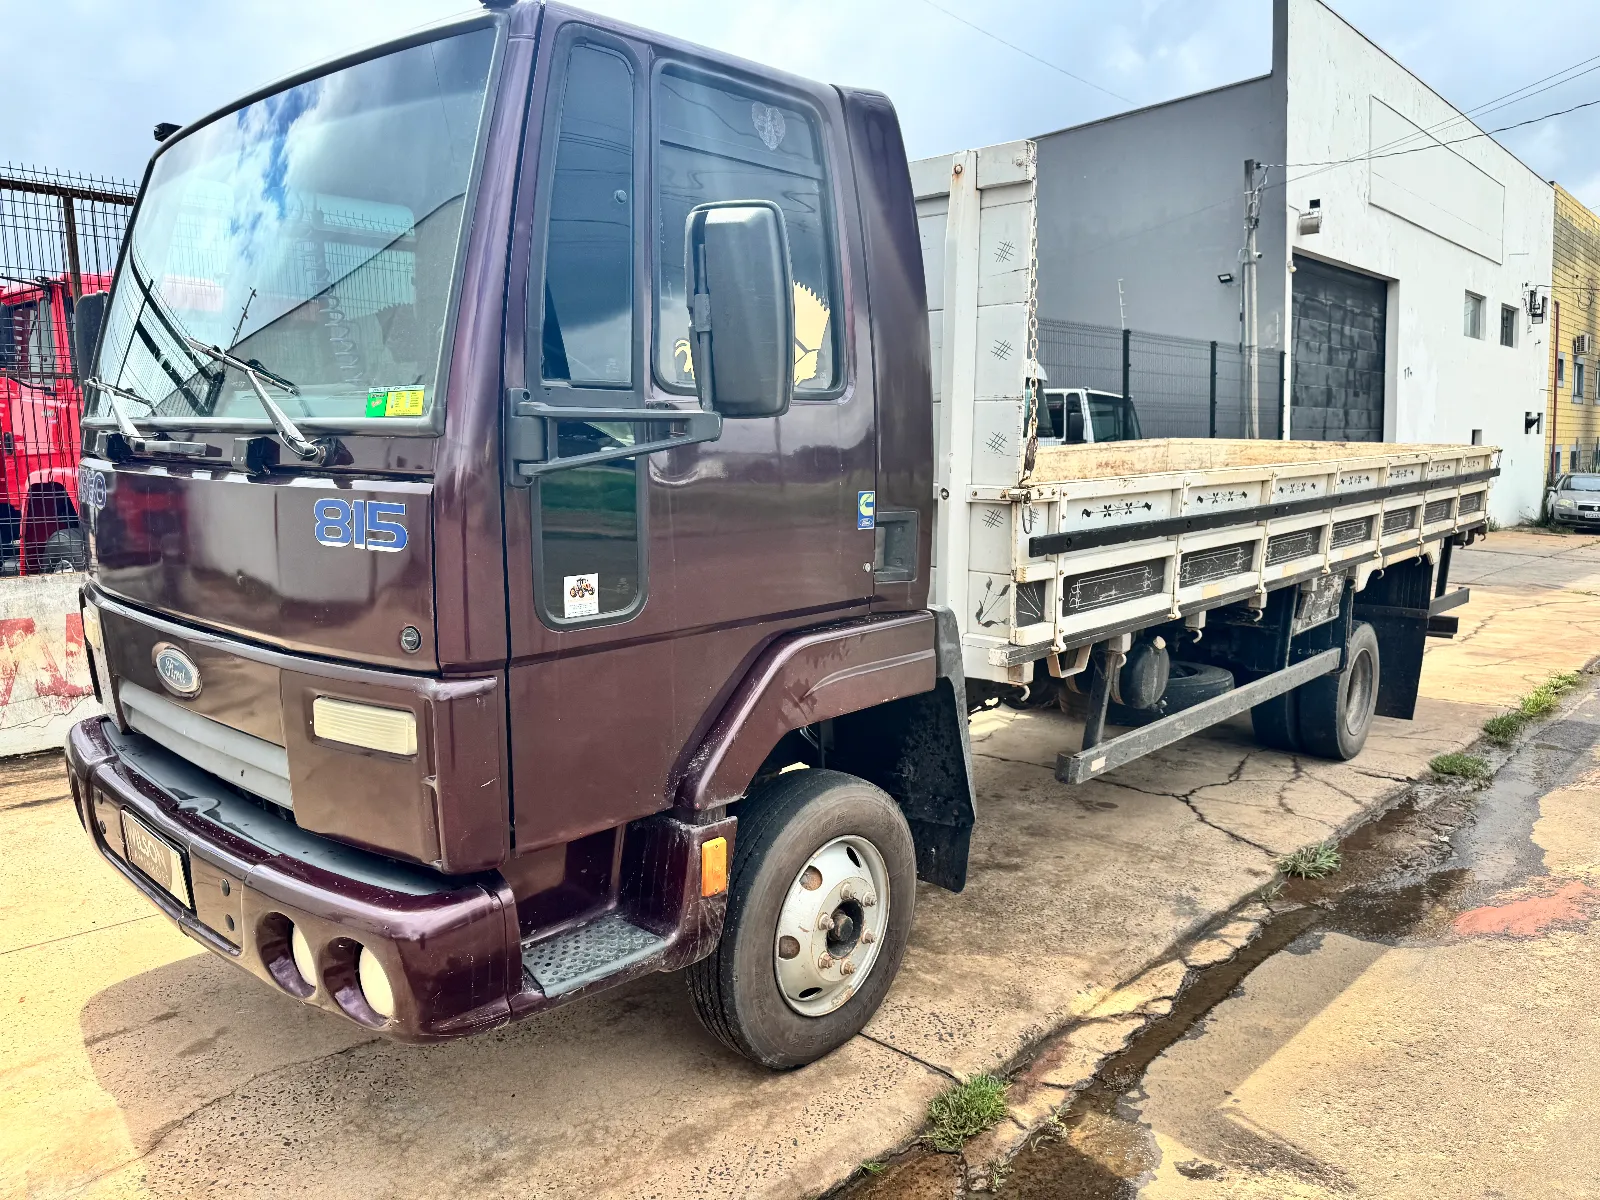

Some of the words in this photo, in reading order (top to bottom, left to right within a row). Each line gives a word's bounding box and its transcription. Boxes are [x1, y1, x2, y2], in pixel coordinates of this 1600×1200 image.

[314, 498, 408, 553] 815
[164, 657, 187, 684] Ford
[125, 821, 169, 873] WILSON
